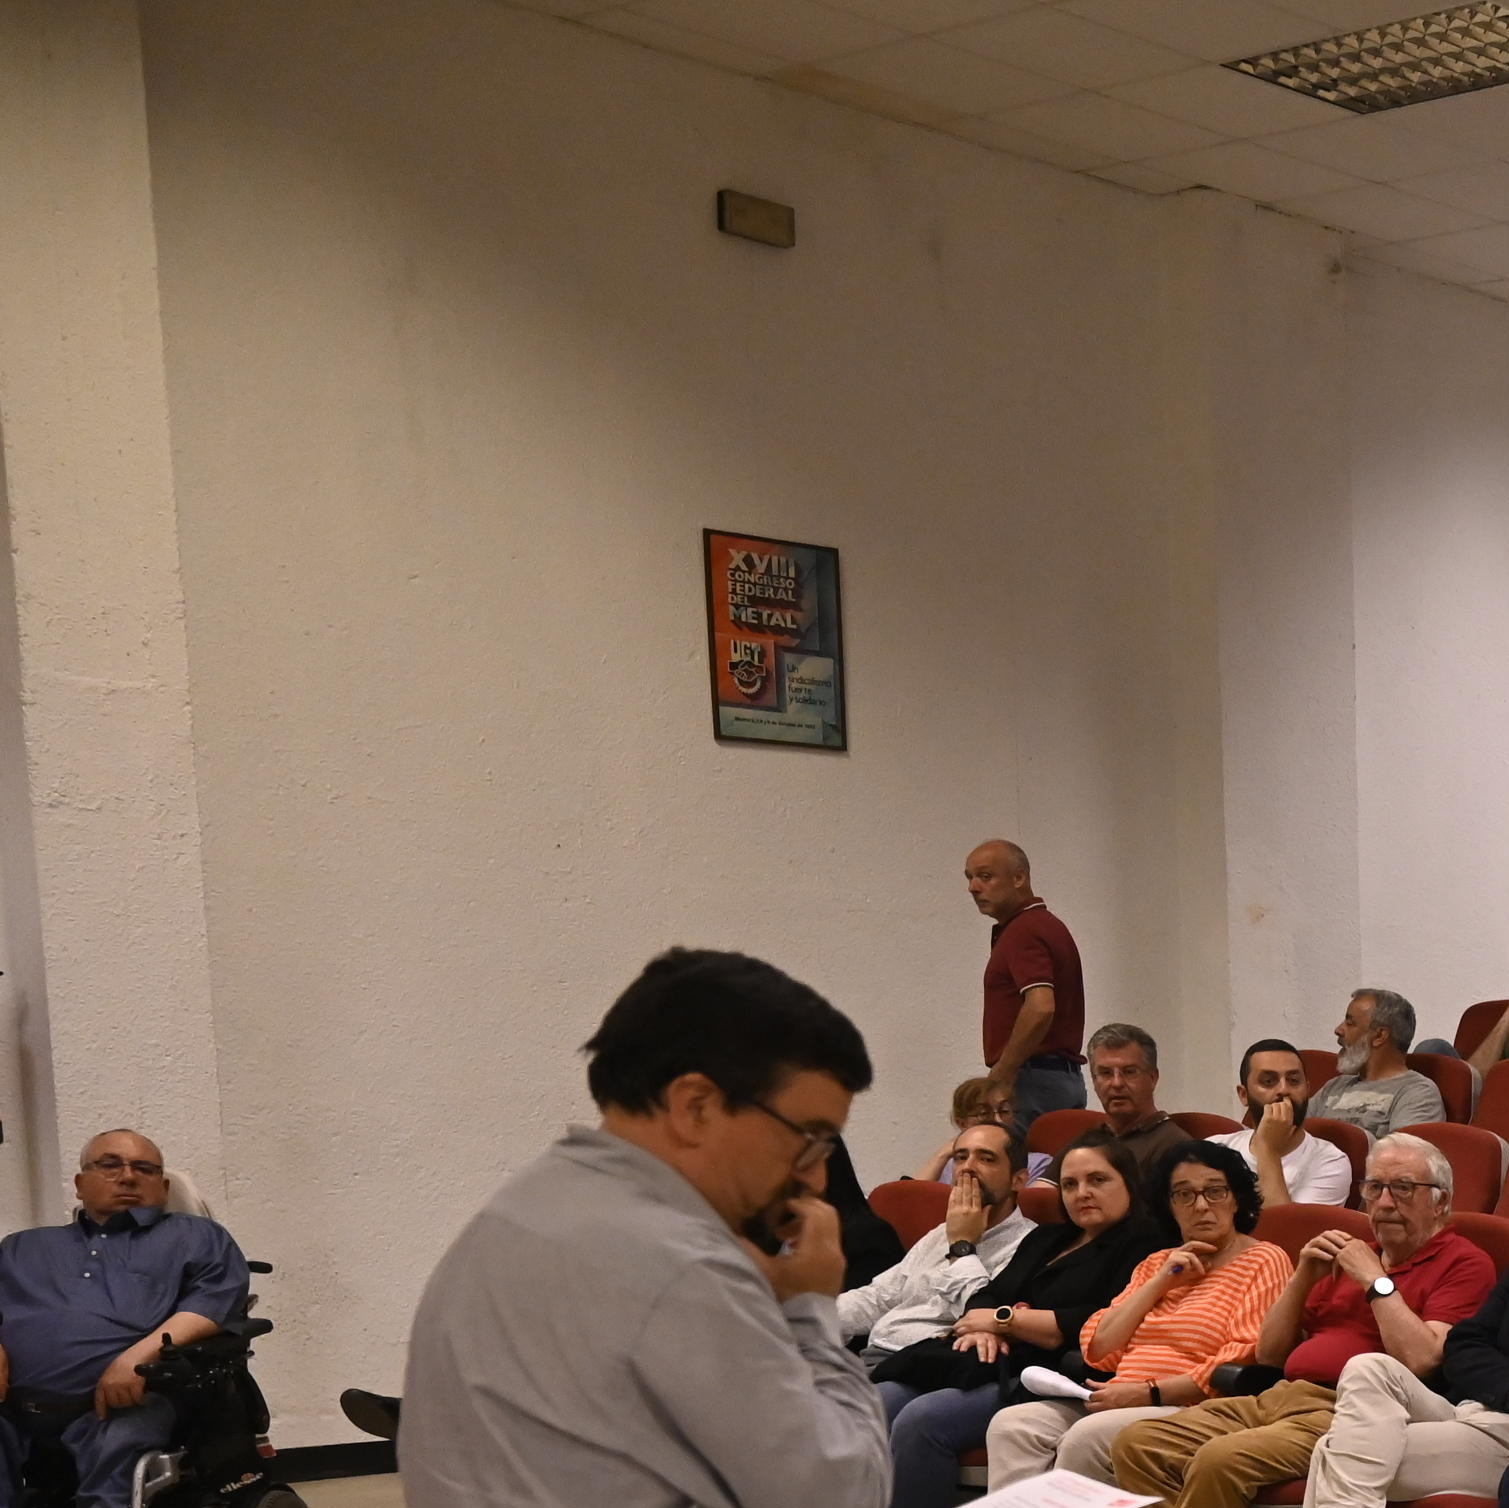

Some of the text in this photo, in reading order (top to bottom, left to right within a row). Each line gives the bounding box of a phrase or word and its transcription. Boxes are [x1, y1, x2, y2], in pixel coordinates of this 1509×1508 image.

[727, 548, 796, 578] XVIII
[726, 570, 796, 589] CONGRESO
[727, 580, 797, 602] FEDERAL
[727, 593, 751, 606] DEL
[728, 605, 798, 629] METAL
[730, 639, 761, 665] UGT
[219, 1471, 264, 1494] ellesse
